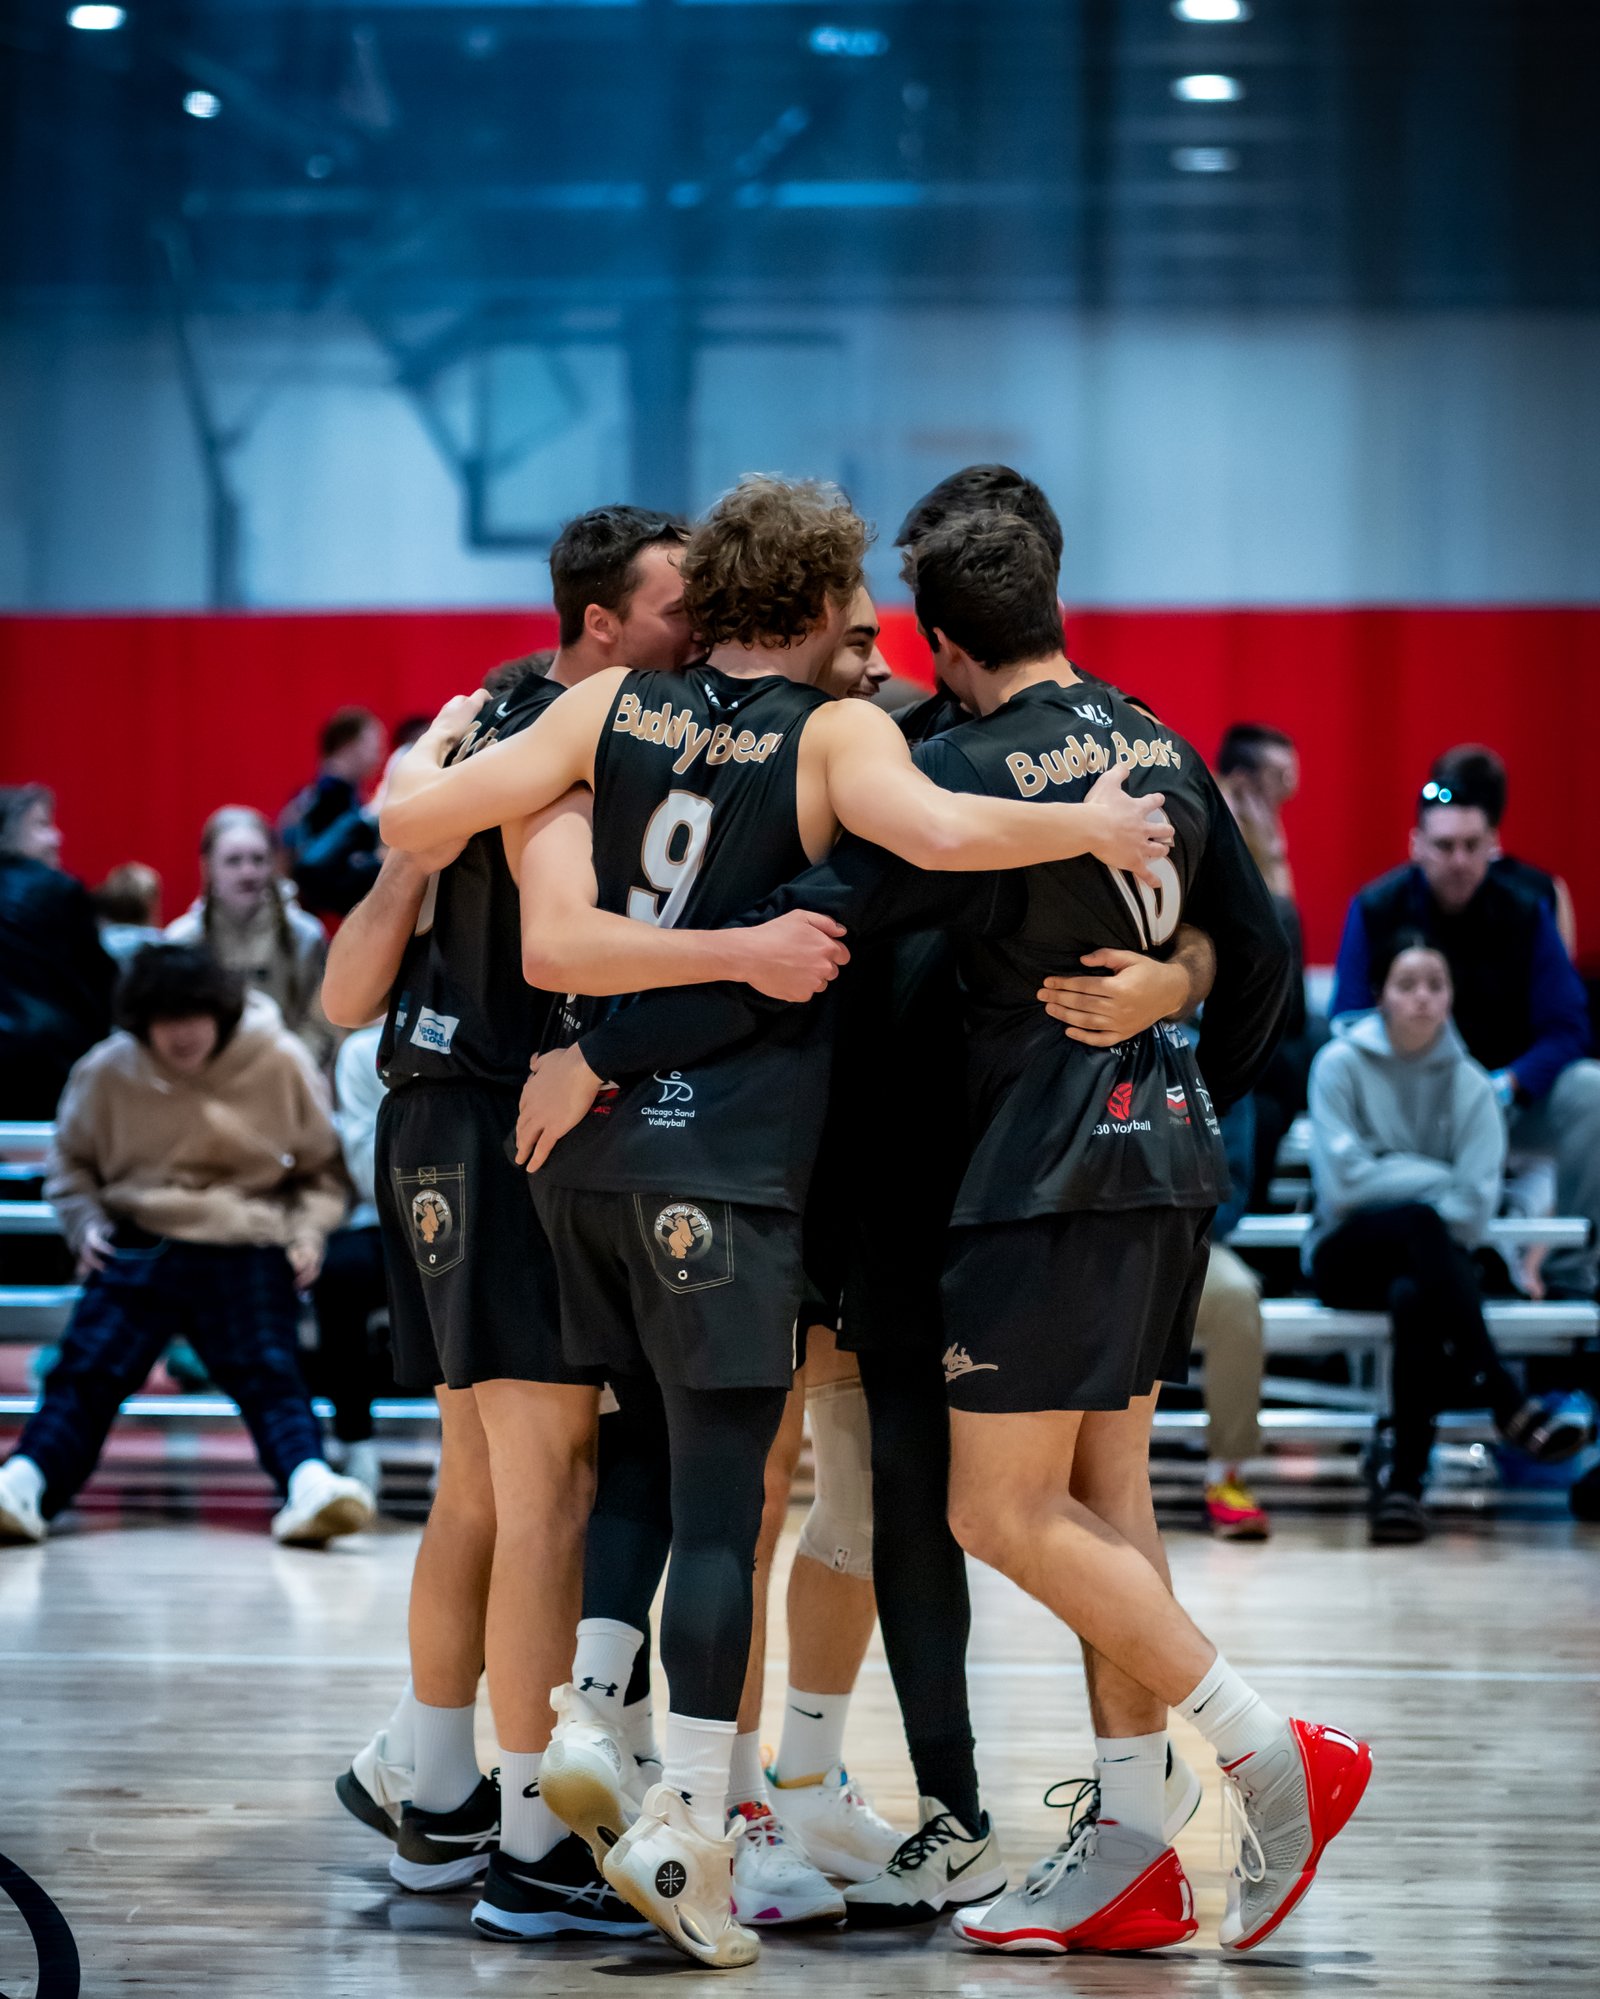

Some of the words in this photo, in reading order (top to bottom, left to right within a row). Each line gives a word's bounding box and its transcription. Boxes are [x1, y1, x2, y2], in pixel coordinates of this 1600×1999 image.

[612, 692, 712, 775] Buddy
[626, 788, 715, 930] 9
[640, 1107, 673, 1119] Chicago
[674, 1108, 696, 1118] Sand
[648, 1117, 686, 1129] Volleyball
[1091, 1123, 1110, 1136] 30
